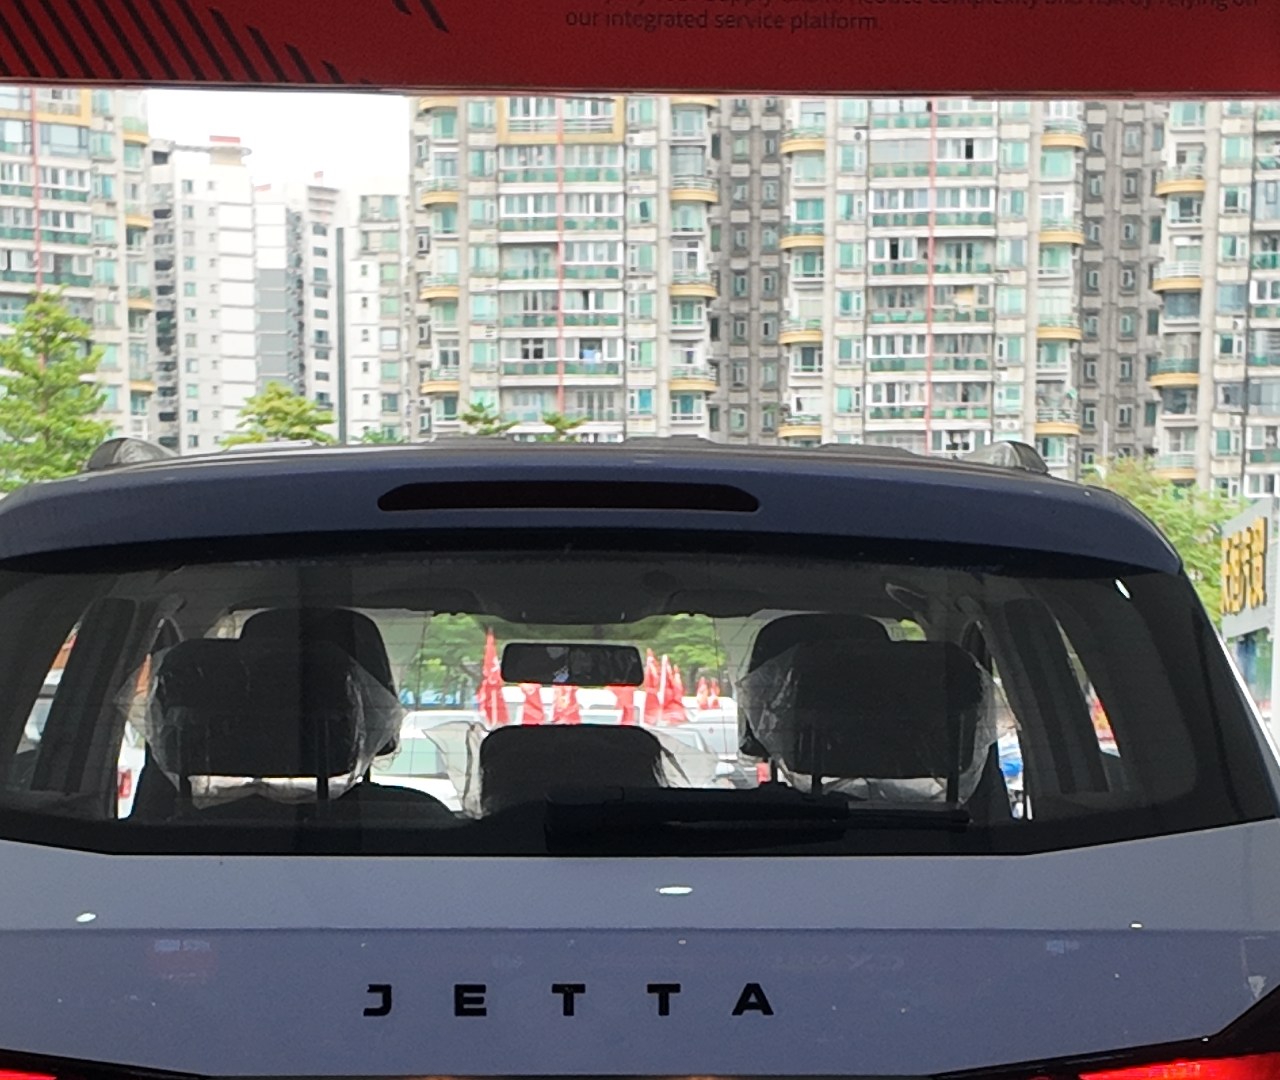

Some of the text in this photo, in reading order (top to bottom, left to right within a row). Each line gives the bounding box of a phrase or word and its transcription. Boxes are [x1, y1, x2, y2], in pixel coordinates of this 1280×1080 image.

[565, 12, 600, 28] our
[606, 9, 708, 32] integrated
[714, 12, 785, 30] service
[363, 983, 775, 1018] JETTA
